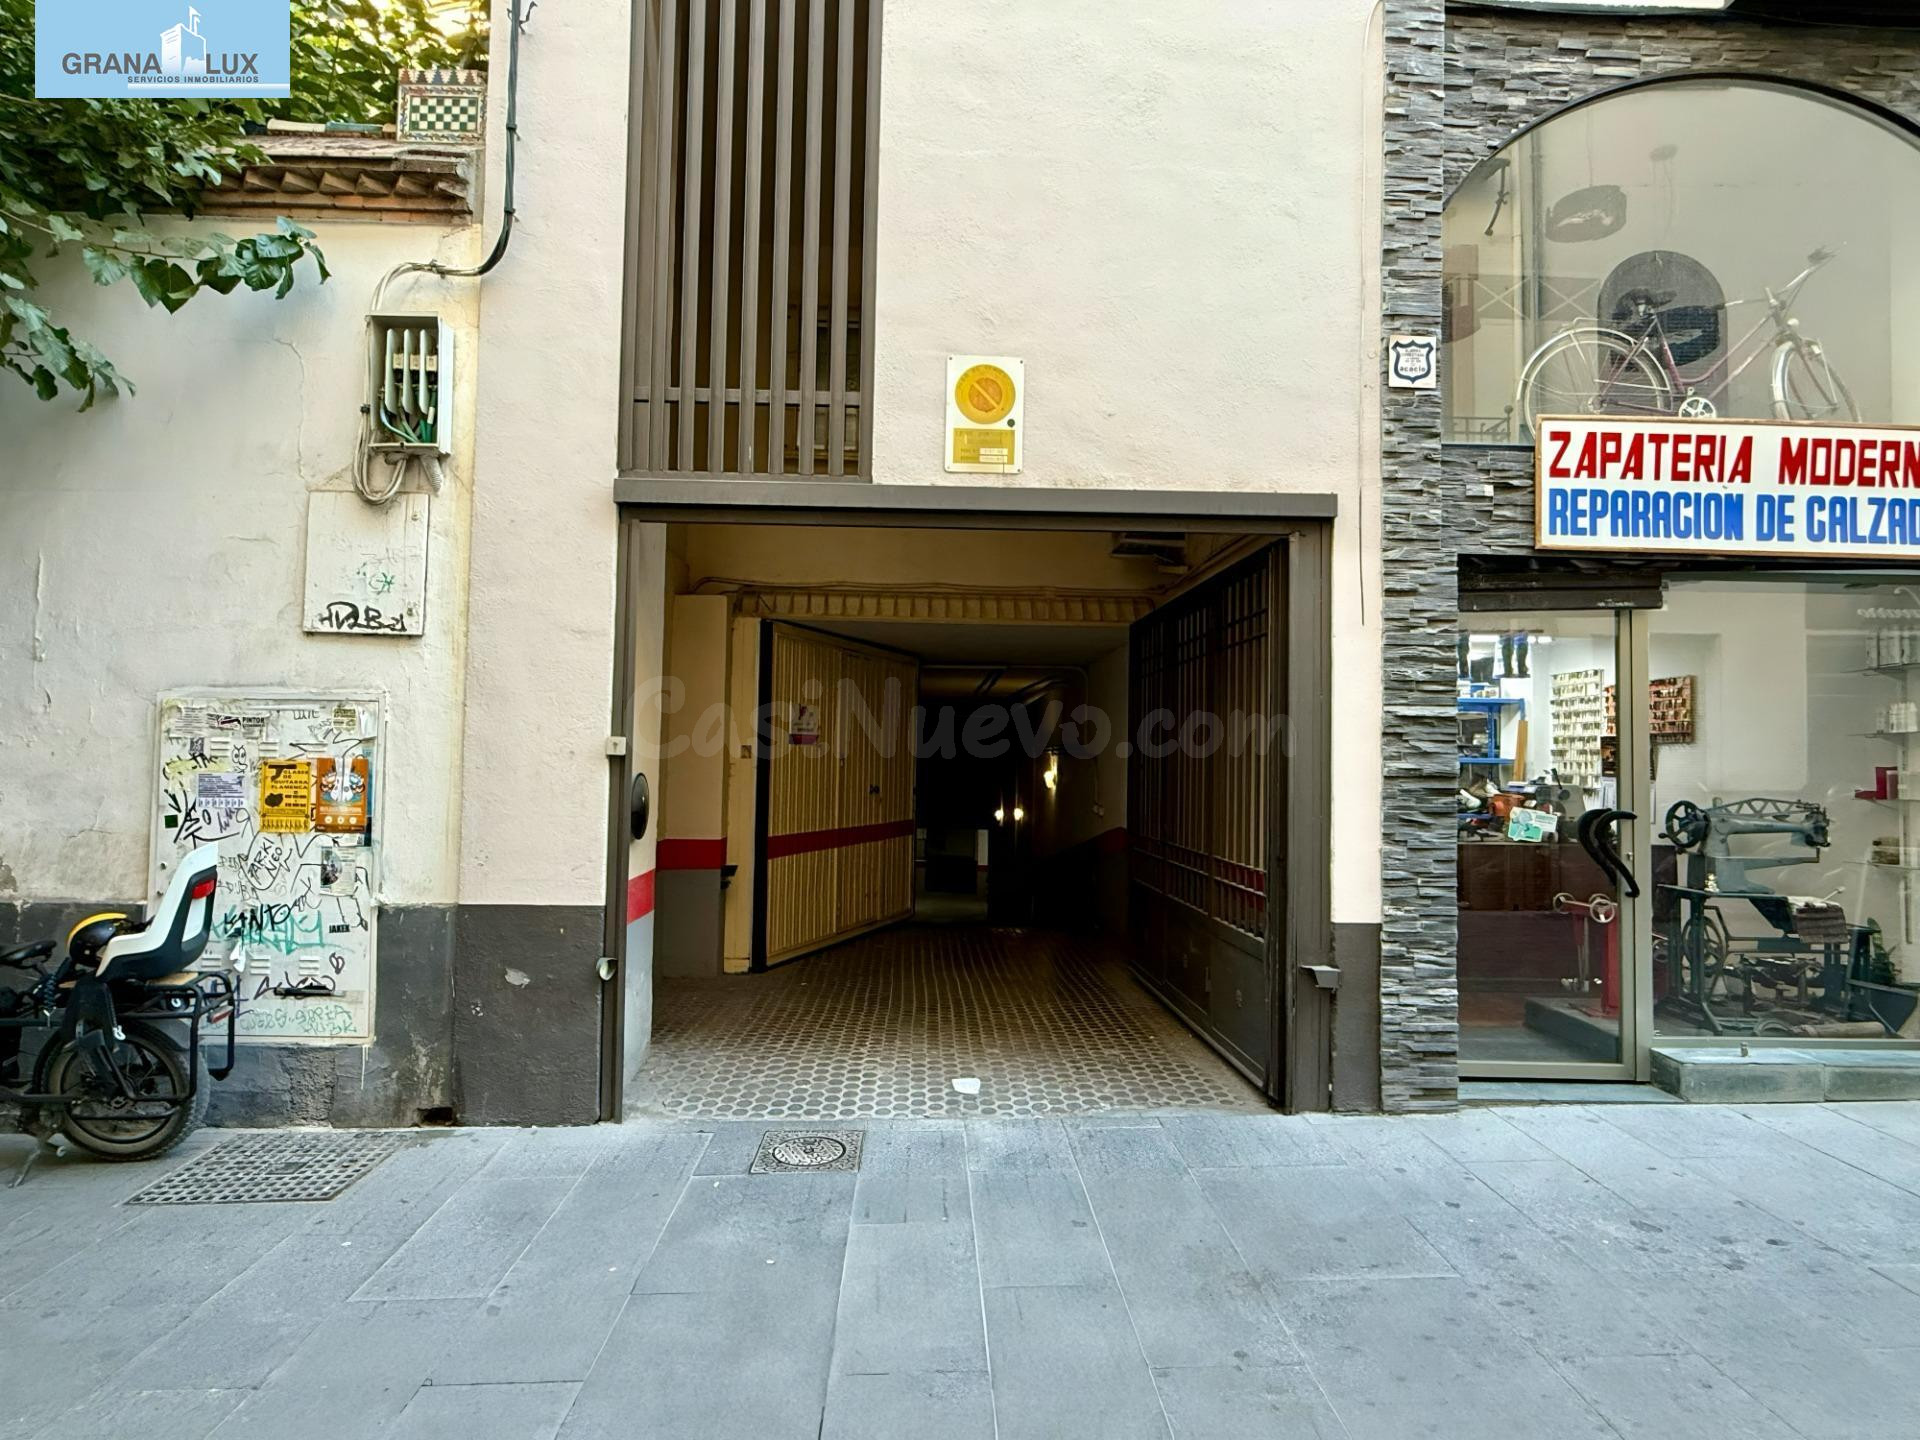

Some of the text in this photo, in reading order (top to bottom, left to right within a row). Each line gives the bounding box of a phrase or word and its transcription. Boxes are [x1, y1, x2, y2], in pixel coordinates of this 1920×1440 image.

[1548, 430, 1920, 489] ZAPATERIA MODERN
[1548, 487, 1744, 541] REPARACION
[1755, 493, 1795, 543] DE
